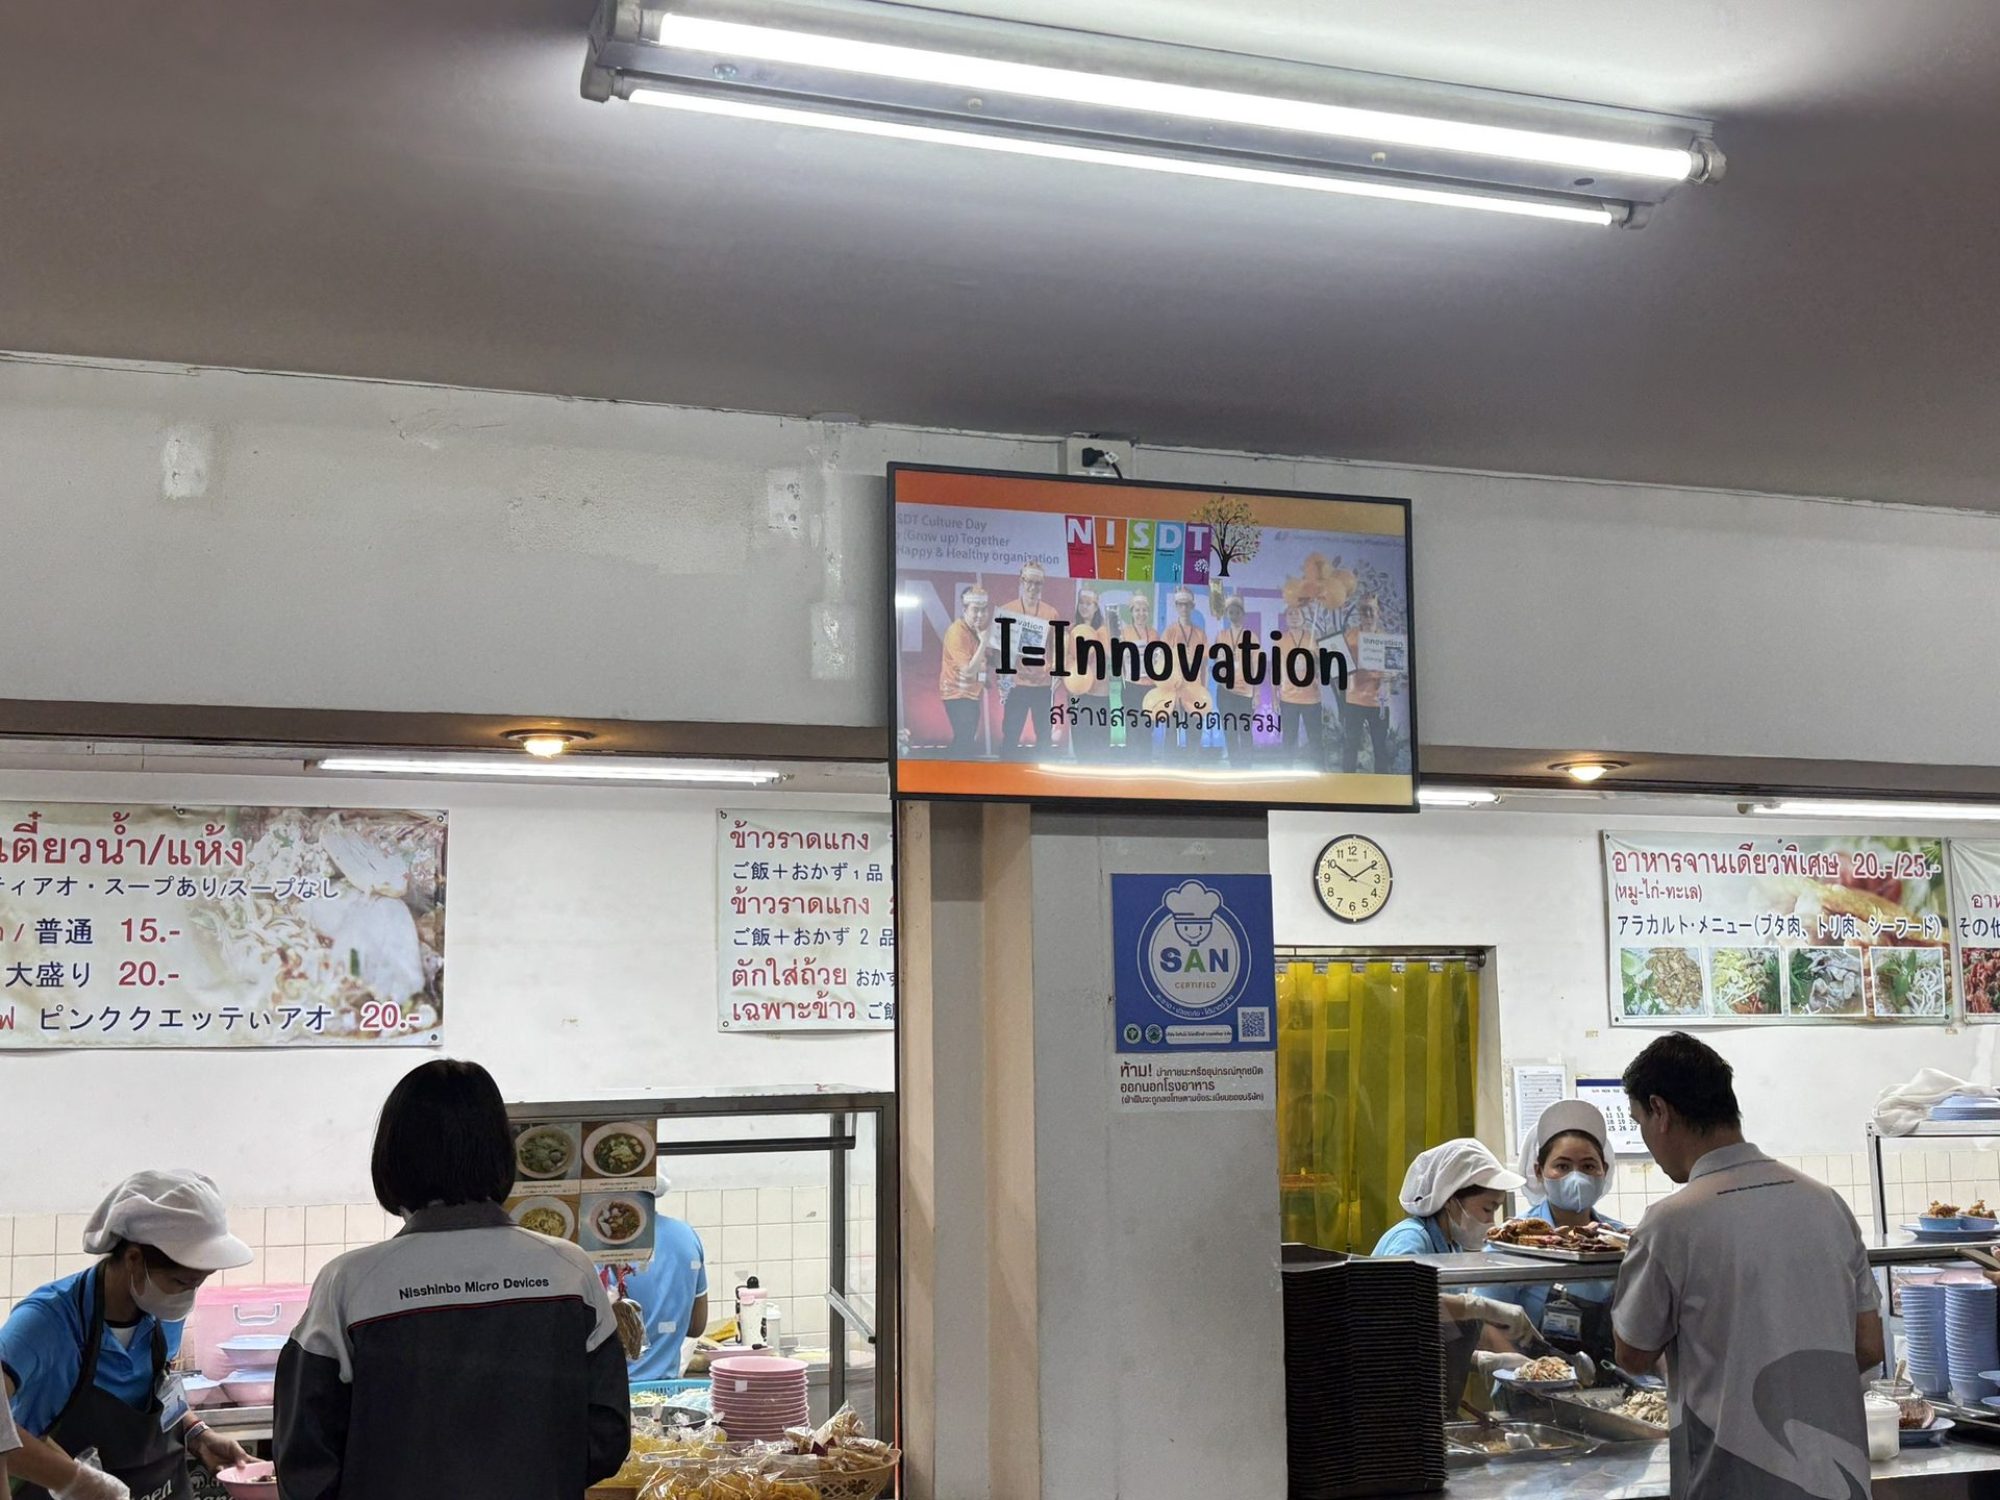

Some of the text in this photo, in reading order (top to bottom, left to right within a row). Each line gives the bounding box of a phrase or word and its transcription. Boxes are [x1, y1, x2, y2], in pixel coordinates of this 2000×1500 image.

[921, 514, 963, 529] Culture
[965, 518, 987, 533] Day
[961, 533, 1010, 547] Together
[1067, 518, 1209, 551] NISDT
[936, 547, 943, 557] &
[946, 547, 990, 562] Healthy
[992, 551, 1060, 566] organization
[995, 617, 1347, 691] I=Innovation
[1050, 698, 1282, 734] สร้างสรรค์นวัตกรรม
[730, 820, 869, 850] ข้าวราดแกง
[1336, 849, 1344, 859] 11
[1347, 846, 1357, 856] 12
[1363, 850, 1367, 859] 1
[1328, 859, 1337, 869] 10
[1612, 843, 1941, 878] อาหารจานเดียวพิเศษ 20.-/25.-
[1324, 873, 1331, 883] 9
[1373, 874, 1381, 884] 3
[731, 886, 870, 914] ข้าวราดแกง
[1327, 887, 1334, 897] 8
[1370, 888, 1377, 897] 4
[1336, 897, 1343, 907] 7
[1349, 901, 1356, 911] 6
[1361, 898, 1369, 908] 5
[35, 918, 93, 944] 普通
[121, 918, 181, 943] 15.-
[1160, 947, 1229, 973] SAN
[5, 961, 180, 988] 大盛り 20.-
[732, 957, 847, 987] ตักใส่ถ้วย
[1175, 981, 1216, 989] CERTIFIED
[733, 990, 856, 1021] เฉพาะข้าว
[362, 1003, 420, 1030] 20.-
[1120, 1061, 1152, 1077] ห้าม!
[1120, 1078, 1216, 1093] ออกนอกโรงอาหาร
[399, 1277, 550, 1300] Nisshinbo Micro Devices
